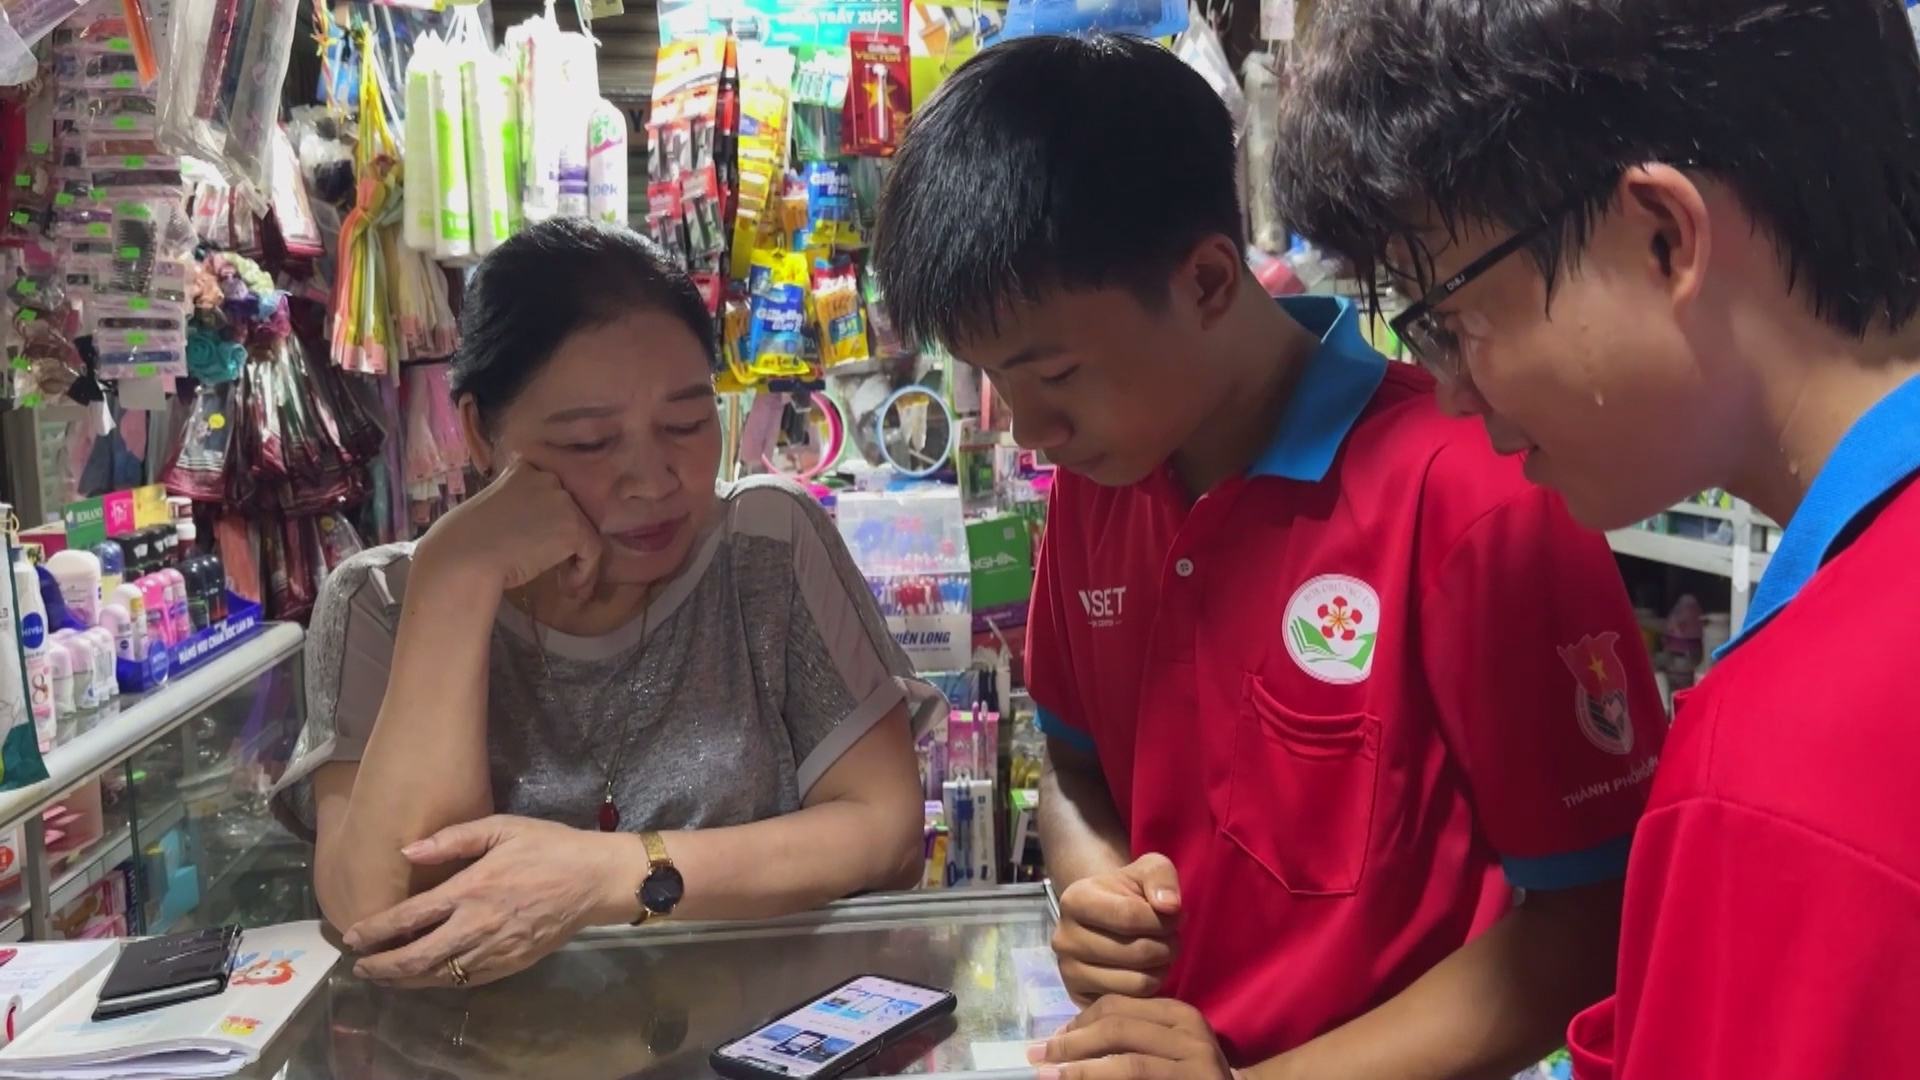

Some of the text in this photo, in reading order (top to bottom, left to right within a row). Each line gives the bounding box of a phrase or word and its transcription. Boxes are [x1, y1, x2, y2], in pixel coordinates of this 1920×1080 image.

[22, 624, 43, 636] NIVEA
[893, 629, 951, 645] IÊN LONG
[1561, 780, 1610, 809] THÀNH
